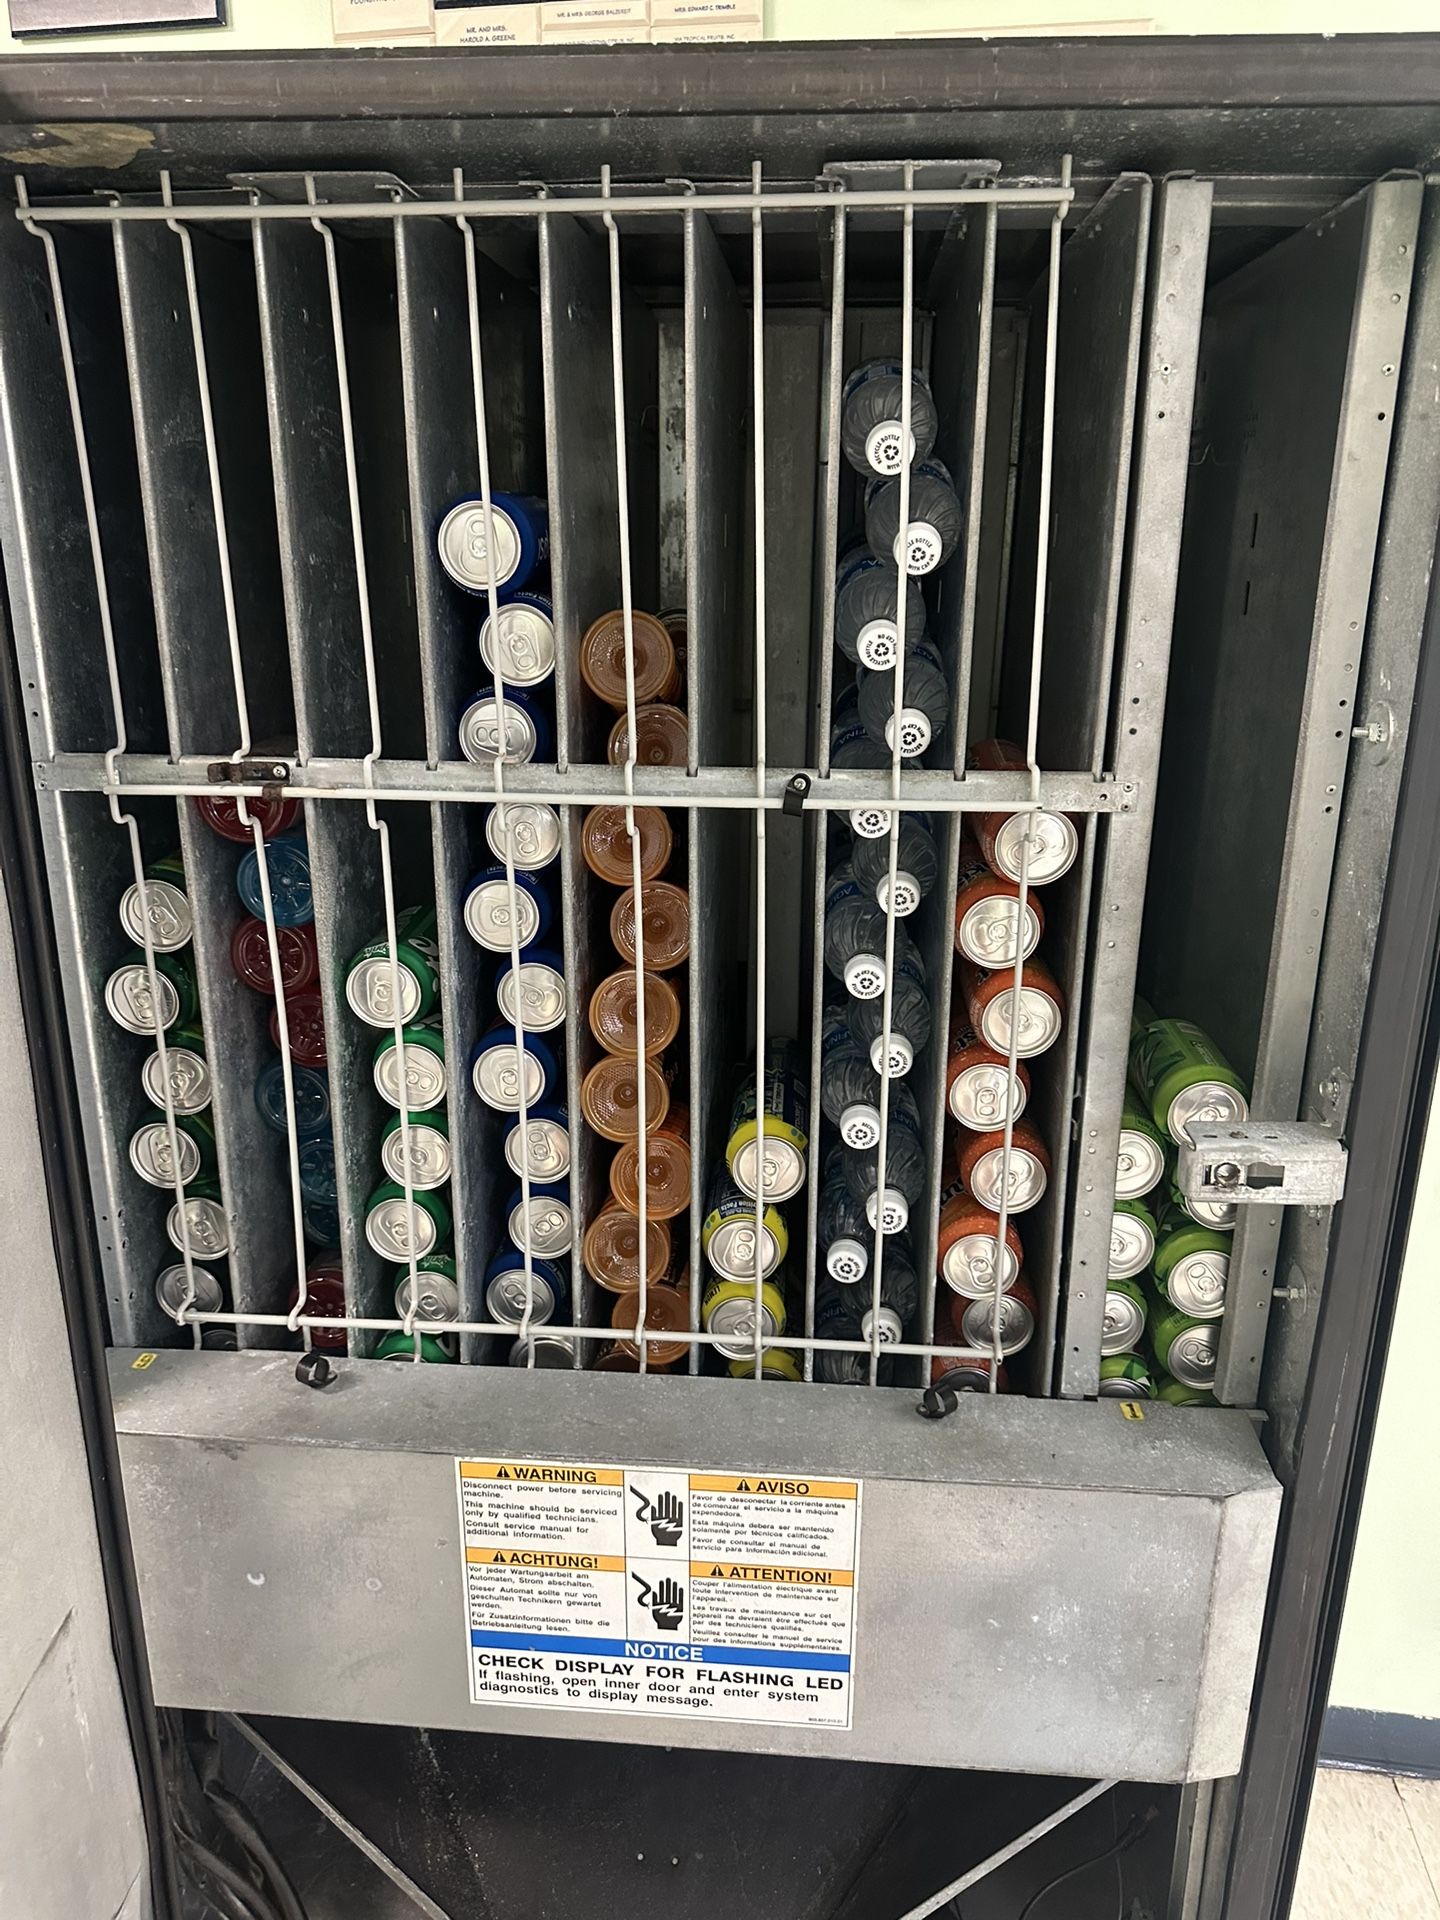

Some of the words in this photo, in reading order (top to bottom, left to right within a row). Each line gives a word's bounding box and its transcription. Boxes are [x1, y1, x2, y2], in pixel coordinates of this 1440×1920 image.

[880, 434, 901, 442] BOTTLE
[915, 537, 933, 548] BOTTLE
[514, 1468, 597, 1482] WARNING
[464, 1482, 512, 1490] Disconnect
[549, 1486, 576, 1494] before
[582, 1489, 622, 1497] servicing
[757, 1482, 809, 1494] AVISO
[488, 1502, 524, 1510] machine
[465, 1510, 483, 1518] only
[504, 1512, 541, 1520] qualified
[546, 1514, 598, 1523] technicians.
[806, 1508, 838, 1516] máquina
[466, 1520, 499, 1528] Consult
[795, 1525, 834, 1533] mantenido
[514, 1531, 565, 1540] information.
[787, 1532, 829, 1540] calificados.
[746, 1547, 790, 1556] información
[792, 1549, 828, 1557] adicional.
[510, 1553, 598, 1568] ACHTUNG!
[511, 1569, 572, 1579] Wartungsarbeit
[730, 1567, 831, 1583] ATTENTION!
[470, 1575, 515, 1584] Automaten,
[548, 1579, 594, 1588] abschalten.
[723, 1581, 772, 1590] l'alimentation
[776, 1585, 812, 1593] électrique
[471, 1594, 514, 1603] geschulten
[518, 1596, 562, 1604] Technikern
[715, 1588, 759, 1597] intervention
[776, 1592, 822, 1601] maintenance
[710, 1605, 736, 1613] travaux
[754, 1608, 800, 1616] maintenance
[489, 1613, 571, 1623] Zusatzinformationen
[692, 1612, 721, 1620] appareil
[738, 1614, 772, 1622] devraient
[794, 1618, 827, 1626] effectués
[473, 1620, 541, 1631] Betriebsanleitung
[726, 1621, 767, 1629] techniciens
[771, 1624, 803, 1632] qualifiés.
[724, 1630, 757, 1638] consulter
[773, 1633, 799, 1641] manuel
[730, 1638, 775, 1647] informations
[780, 1642, 841, 1651] supplémentaires.
[625, 1643, 703, 1661] NOTICE
[479, 1655, 544, 1670] CHECK
[556, 1660, 634, 1676] DISPLAY
[646, 1666, 684, 1679] FOR
[697, 1670, 794, 1687] FLASHING
[807, 1677, 843, 1691] LED
[479, 1670, 488, 1679] If
[495, 1670, 554, 1686] flashing,
[562, 1677, 595, 1688] open
[605, 1678, 639, 1690] inner
[648, 1681, 681, 1692] door
[689, 1684, 715, 1695] and
[723, 1689, 759, 1699] enter
[767, 1691, 818, 1703] system
[480, 1681, 559, 1696] diagnostics
[567, 1688, 580, 1697] to
[589, 1688, 637, 1704] display
[646, 1693, 712, 1708] message.
